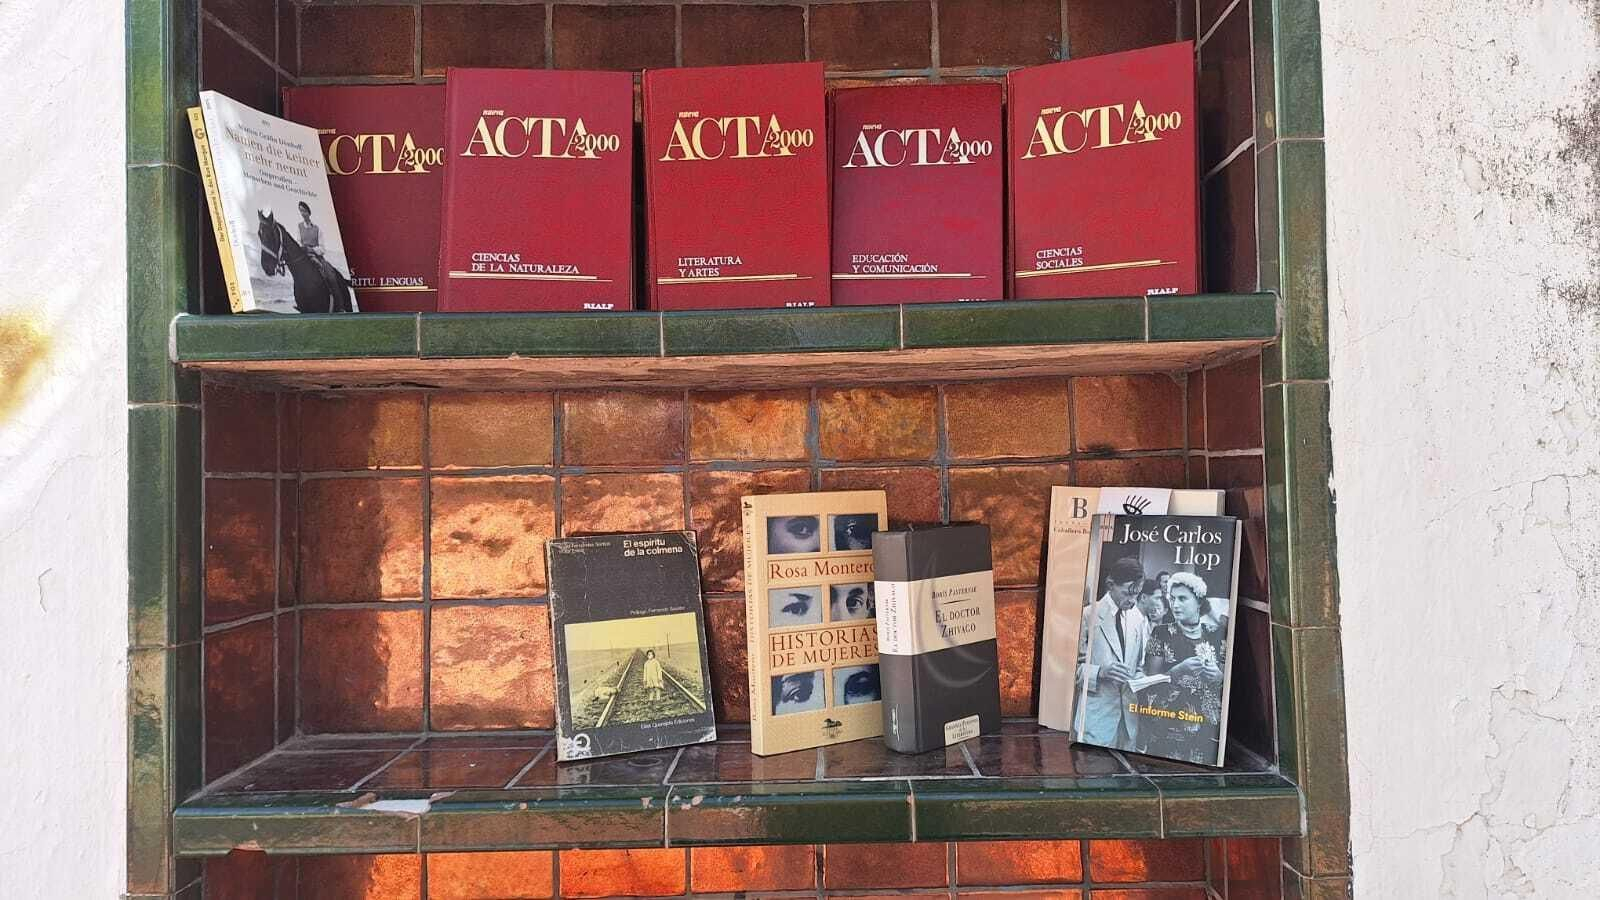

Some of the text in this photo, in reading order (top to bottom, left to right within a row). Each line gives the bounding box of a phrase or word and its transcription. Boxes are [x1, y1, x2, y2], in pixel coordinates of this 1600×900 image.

[1020, 99, 1182, 160] ACTA 2000
[460, 116, 620, 159] ACTA 2000
[659, 114, 814, 161] ACTA 2000
[326, 132, 431, 176] CTA
[842, 127, 993, 168] ACTA 2000
[472, 253, 521, 263] CIENCIAS
[852, 252, 908, 264] EDUCACIÓN
[1036, 246, 1083, 259] CIENCIAS
[472, 263, 580, 275] DE LA NATURALEZA
[678, 256, 742, 267] LITERATURA
[852, 262, 938, 274] Y COMUNICACIÓN
[1036, 257, 1083, 270] SOCIALES
[679, 267, 720, 278] Y ARTES
[380, 277, 424, 287] LENGUAS
[1071, 497, 1088, 519] B
[1119, 523, 1222, 545] José Carlos
[623, 540, 632, 548] El
[624, 546, 683, 557] de la colmena
[1173, 546, 1220, 570] Llop
[770, 562, 808, 579] Rosa
[936, 607, 980, 623] EL DOCTOR
[942, 623, 976, 638] ZHIVAGO
[772, 653, 795, 668] DE
[1129, 703, 1204, 723] El informe Stein
